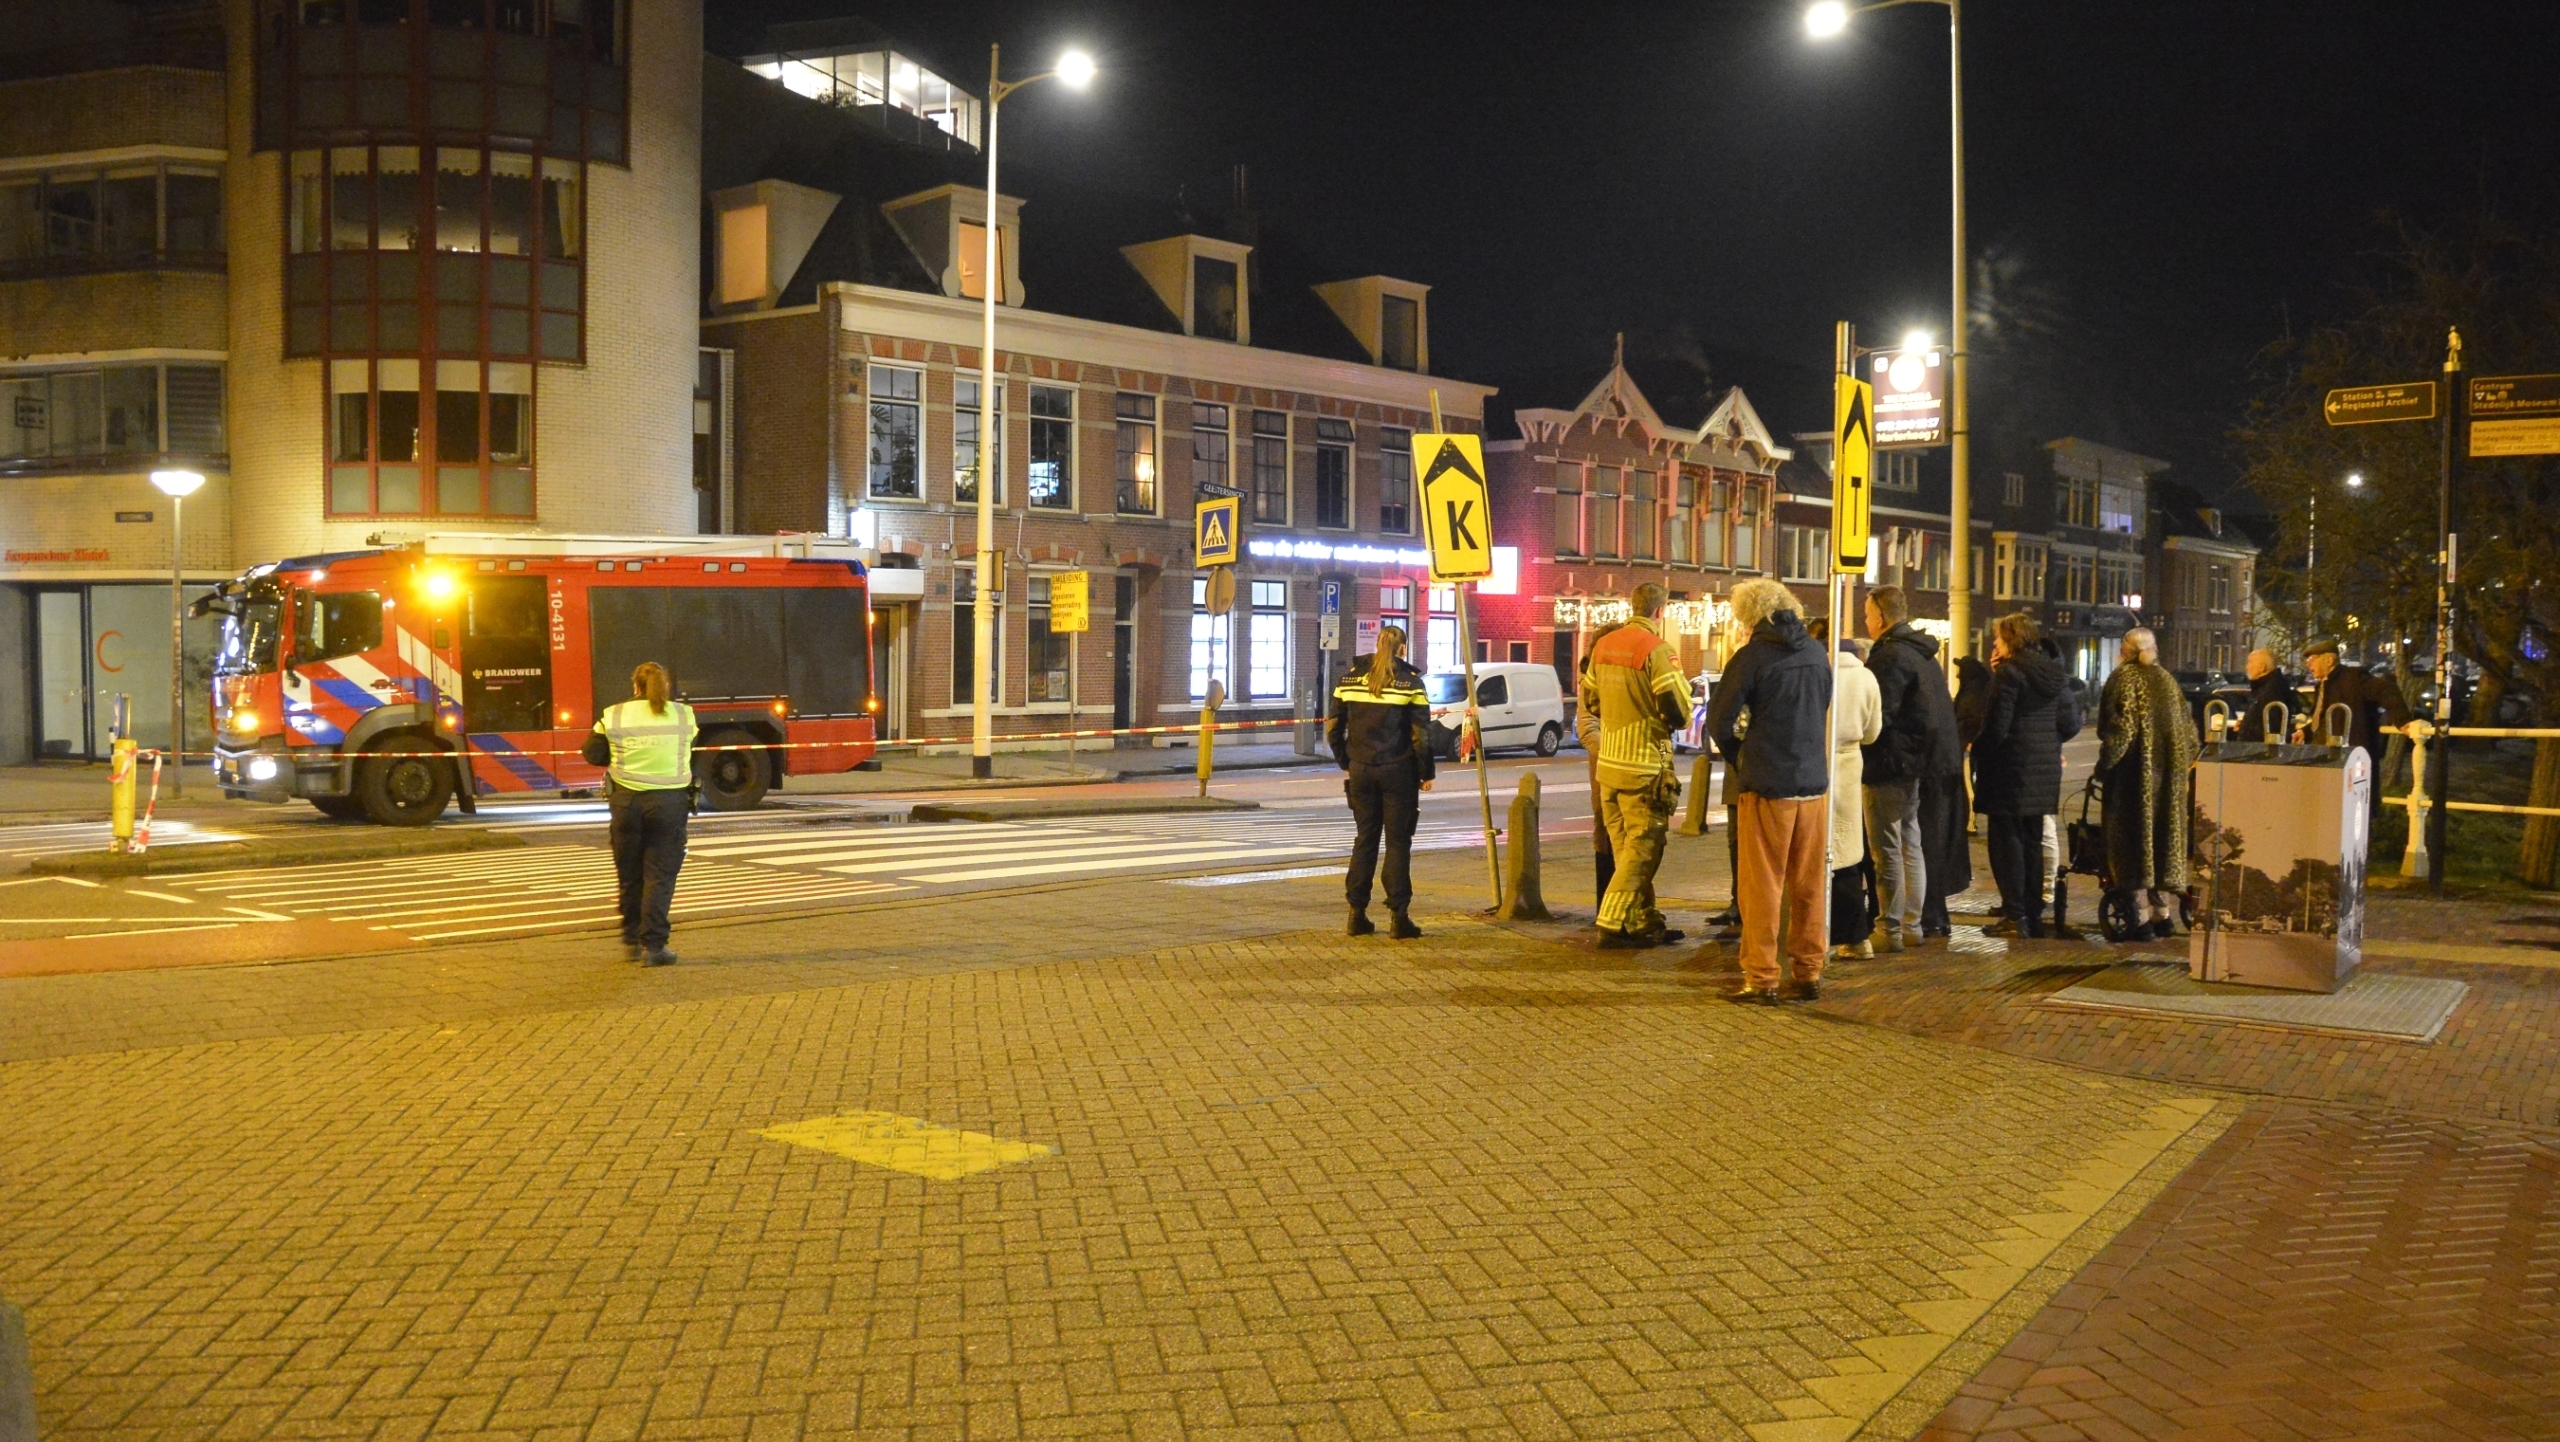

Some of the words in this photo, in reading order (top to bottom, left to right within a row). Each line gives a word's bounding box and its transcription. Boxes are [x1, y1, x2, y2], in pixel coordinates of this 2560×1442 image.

[2474, 382, 2514, 391] Centrum
[2341, 400, 2384, 411] Regionaal
[2386, 396, 2419, 407] Archief
[2342, 392, 2374, 402] Station
[2473, 400, 2515, 410] Stedelijk
[2516, 398, 2557, 408] Museum
[1448, 500, 1480, 551] K
[1326, 584, 1336, 601] P
[551, 590, 565, 651] 10-4131
[484, 668, 542, 677] BRANDWEER
